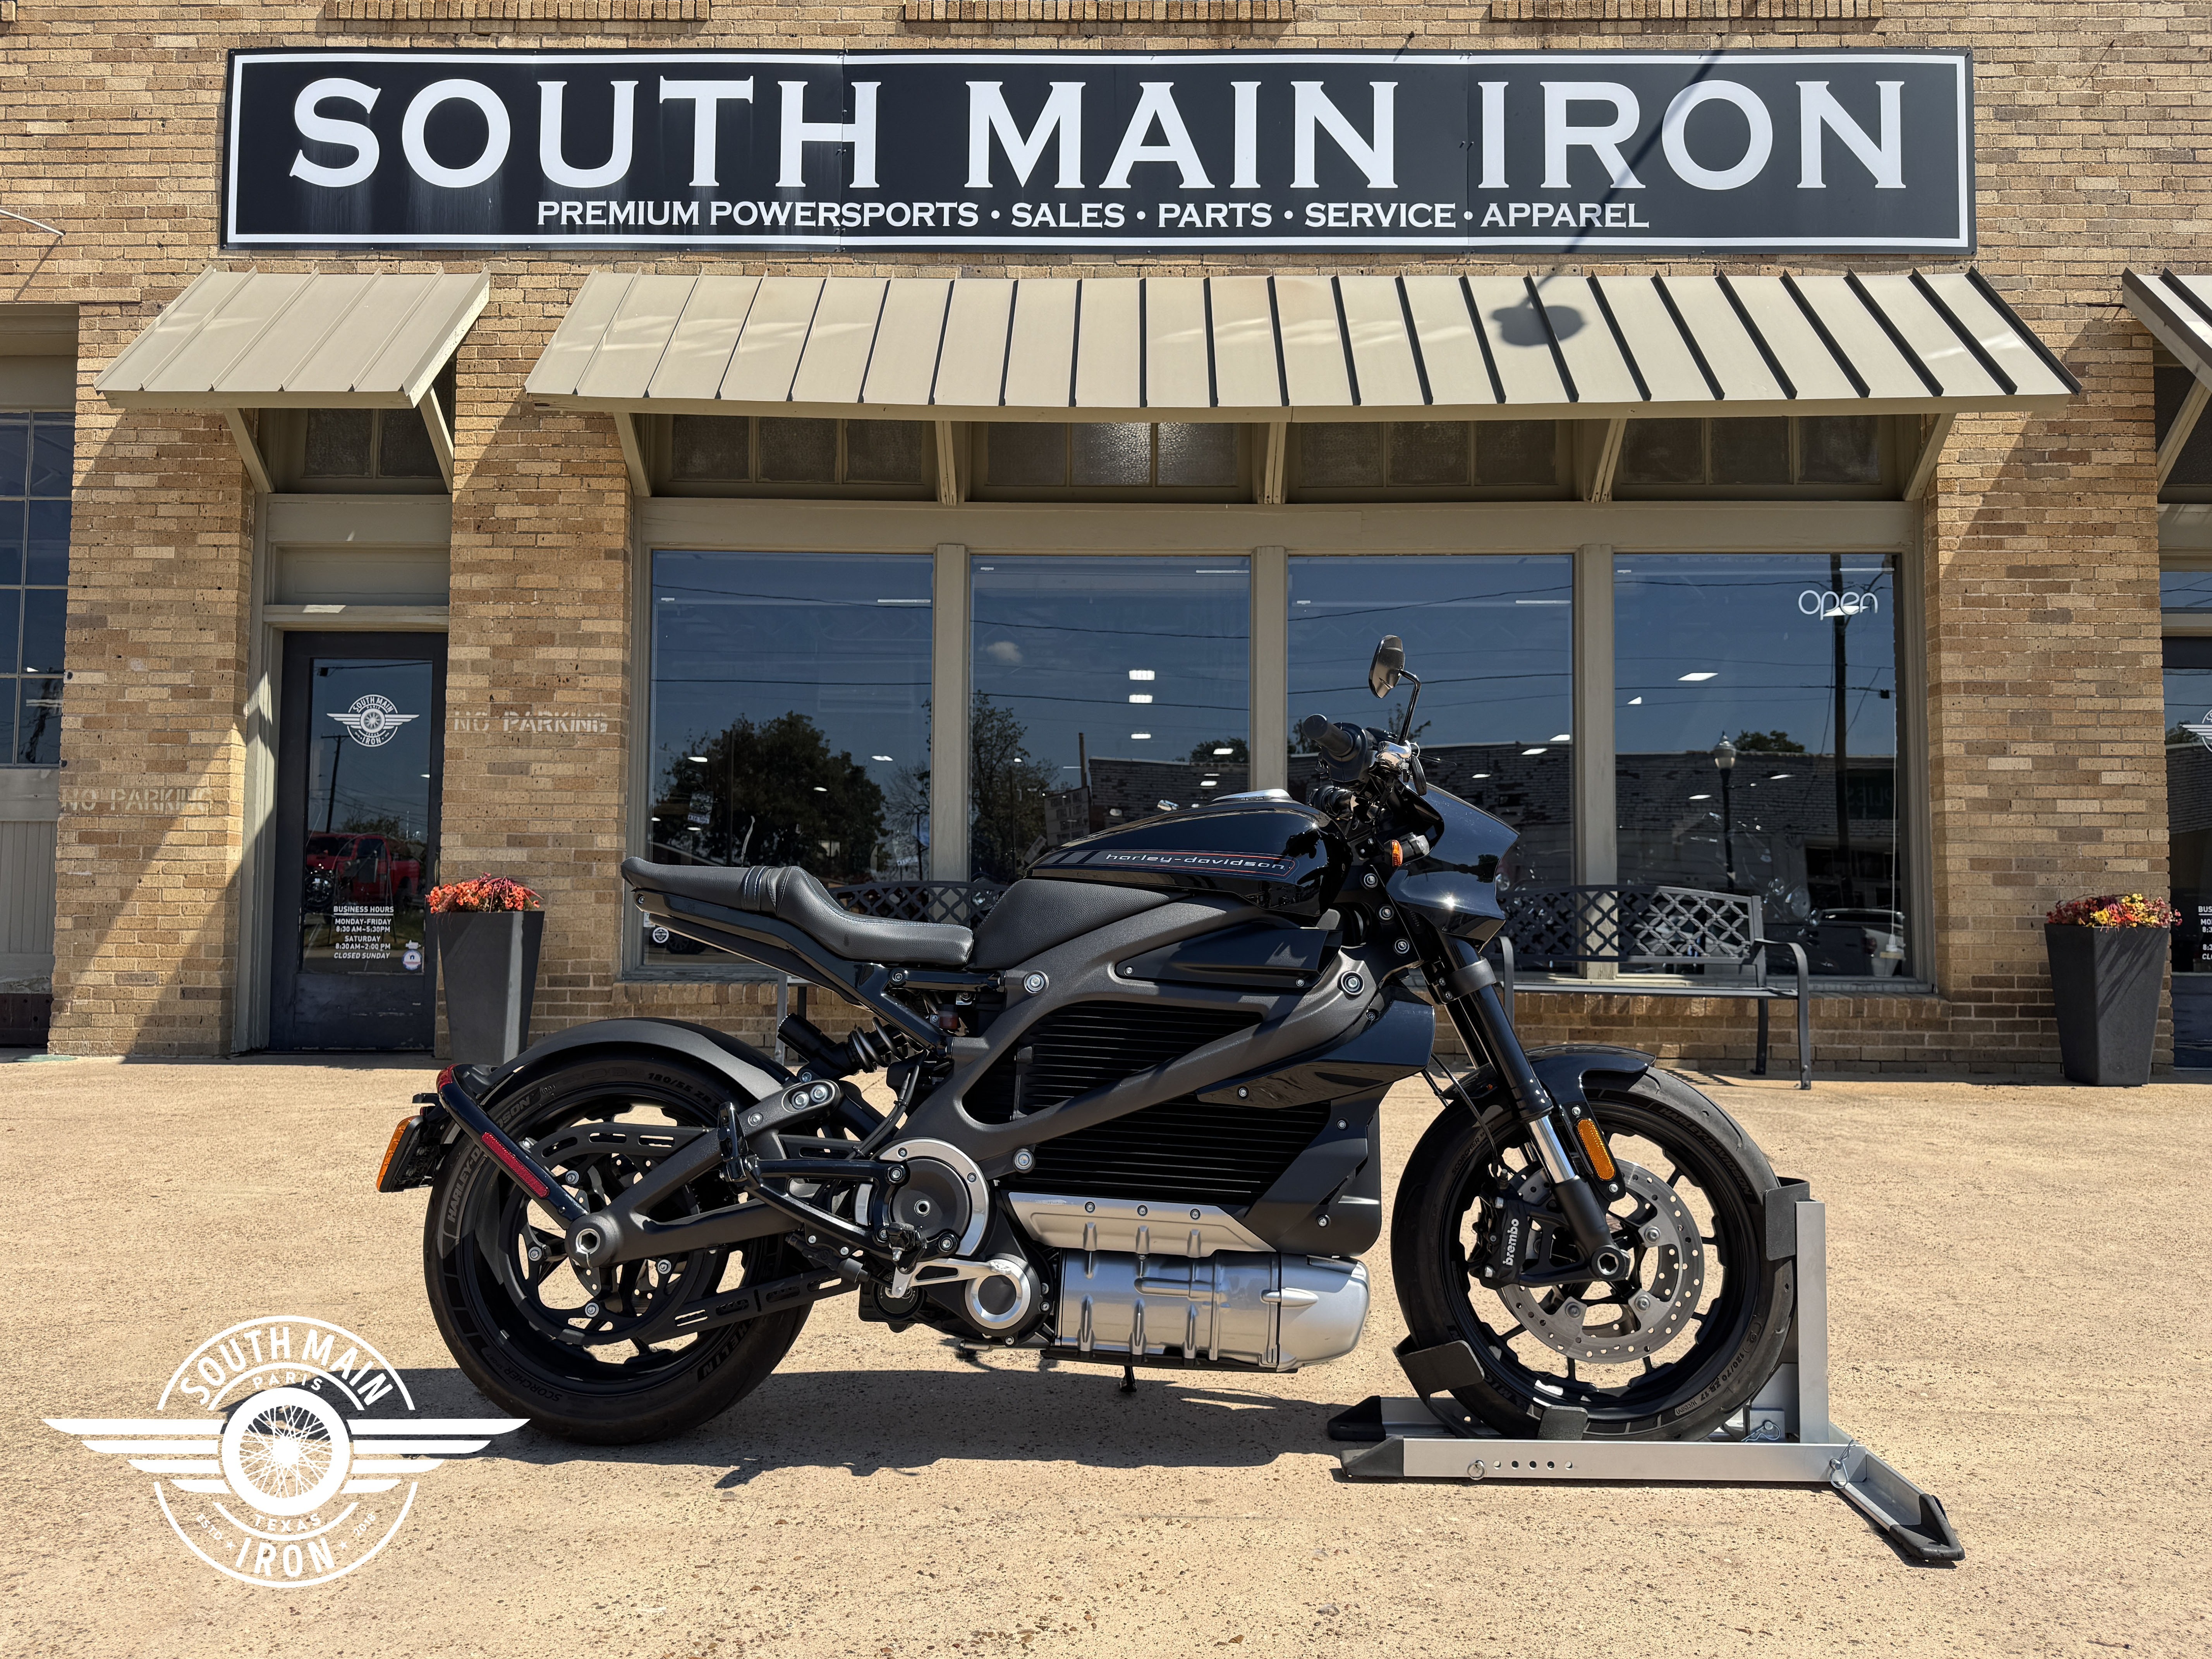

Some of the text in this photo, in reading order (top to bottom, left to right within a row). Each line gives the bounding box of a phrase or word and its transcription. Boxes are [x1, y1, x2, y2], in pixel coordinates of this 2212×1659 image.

[290, 75, 1906, 190] SOUTH MAIN IRON
[538, 200, 1649, 228] PREMIUM POWERSPORTS SALES PARTS SERVICE APPAREL
[1798, 589, 1878, 620] open
[353, 697, 393, 713] SOUTH MAIN
[453, 711, 608, 733] NO PARKING
[61, 788, 213, 812] NO PARKING
[1106, 854, 1285, 870] harley-davidson
[649, 1072, 693, 1092] 180/55
[694, 1091, 712, 1104] ZR
[1452, 1137, 1480, 1175] SCORCHER
[1658, 1107, 1753, 1195] HARLEY-DAVIDSON
[1502, 1218, 1519, 1266] brembo
[486, 1353, 562, 1401] SCORCHER SPORT
[1721, 1353, 1745, 1381] 120/70
